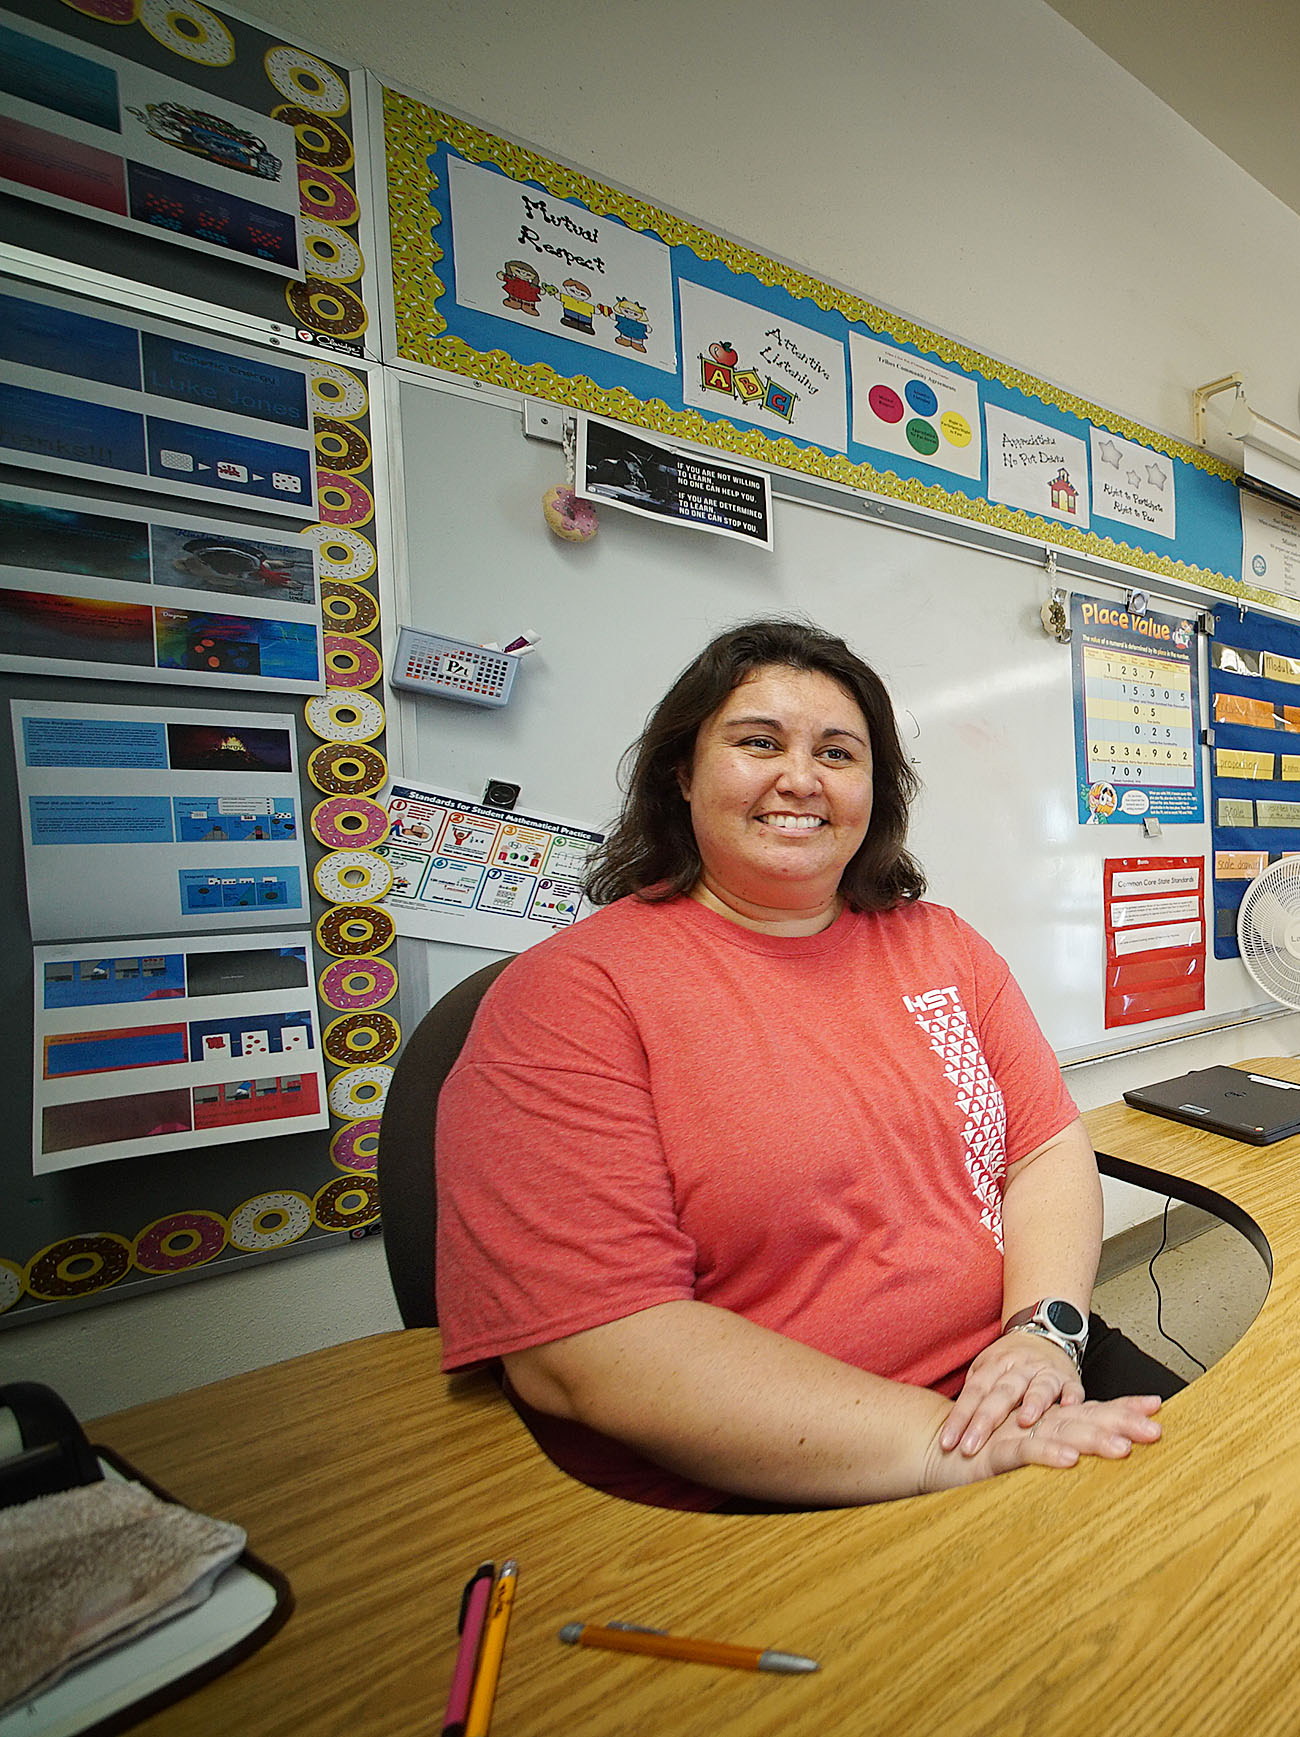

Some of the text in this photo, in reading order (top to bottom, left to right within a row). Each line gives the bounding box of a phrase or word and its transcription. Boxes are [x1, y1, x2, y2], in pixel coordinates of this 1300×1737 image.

[521, 195, 599, 243] Mutual
[517, 225, 605, 274] Respect
[765, 328, 830, 380] Attentive
[760, 346, 819, 395] Listening
[709, 369, 787, 412] A B C
[678, 469, 687, 478] TO
[1003, 453, 1018, 468] No
[1019, 453, 1037, 466] Put
[677, 462, 761, 490] IF YOU ARE NOT WILLING
[678, 477, 689, 486] NO
[690, 481, 705, 490] ONE
[706, 484, 720, 494] CAN
[722, 488, 740, 498] HELP
[678, 492, 763, 520] IF YOU ARE DETERMINED
[679, 499, 689, 508] TO
[679, 507, 690, 516] NO
[691, 510, 706, 520] ONE
[708, 513, 722, 523] CAN
[723, 517, 742, 528] STOP
[1081, 603, 1171, 640] Place Value
[408, 791, 592, 840] Standards for Student Mathematical Practice
[1171, 876, 1194, 884] Standards
[902, 985, 960, 1014] HST
